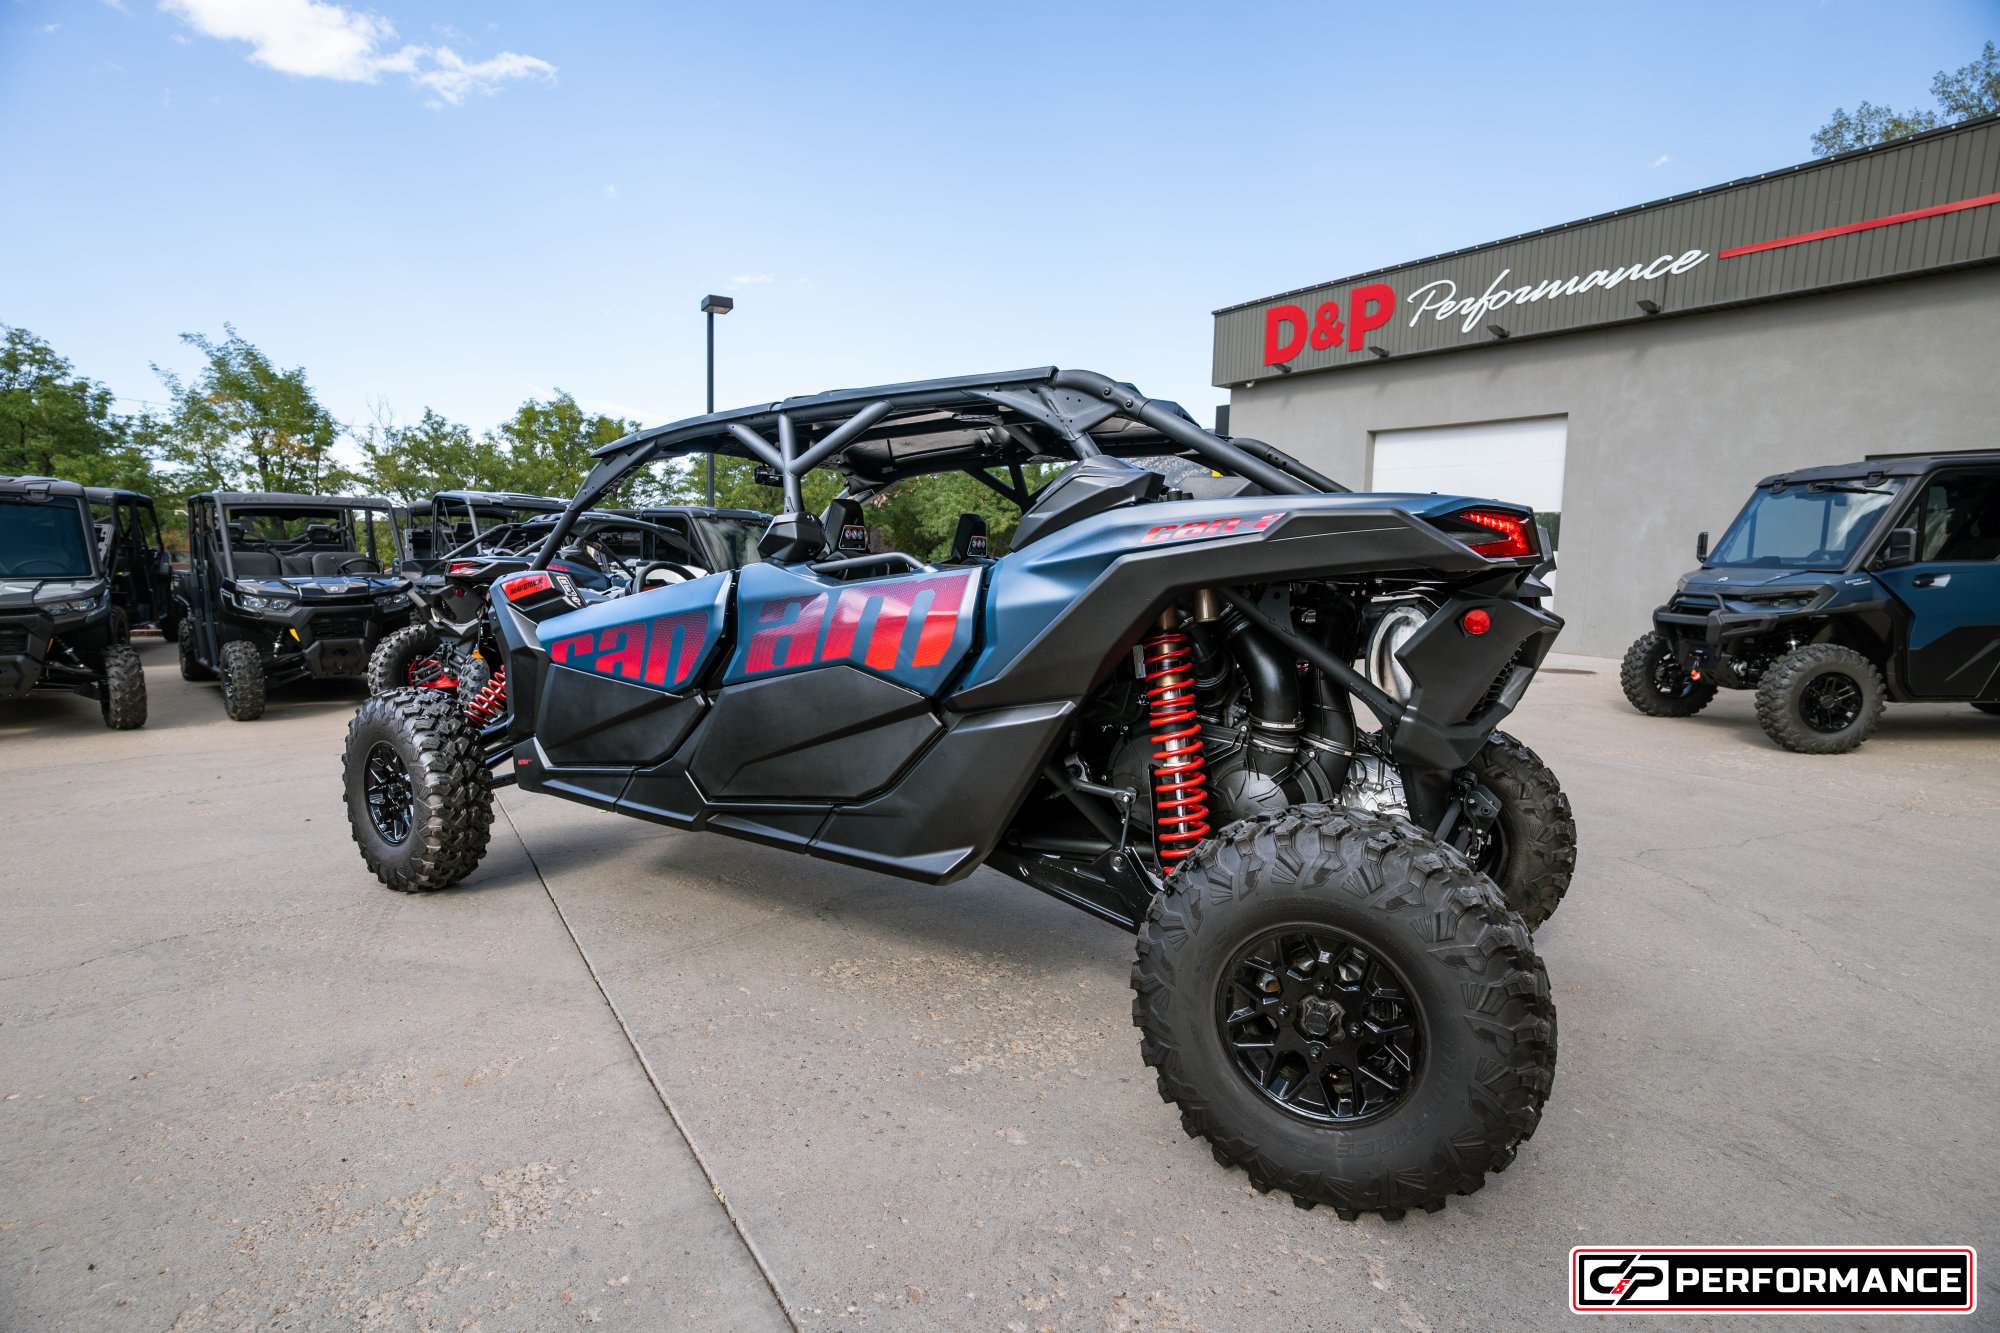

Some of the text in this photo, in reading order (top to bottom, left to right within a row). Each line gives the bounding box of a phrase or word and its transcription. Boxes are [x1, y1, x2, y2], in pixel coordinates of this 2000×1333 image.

[1264, 249, 1709, 366] D&P Performance
[510, 577, 544, 595] MAVERICK
[745, 574, 970, 673] am
